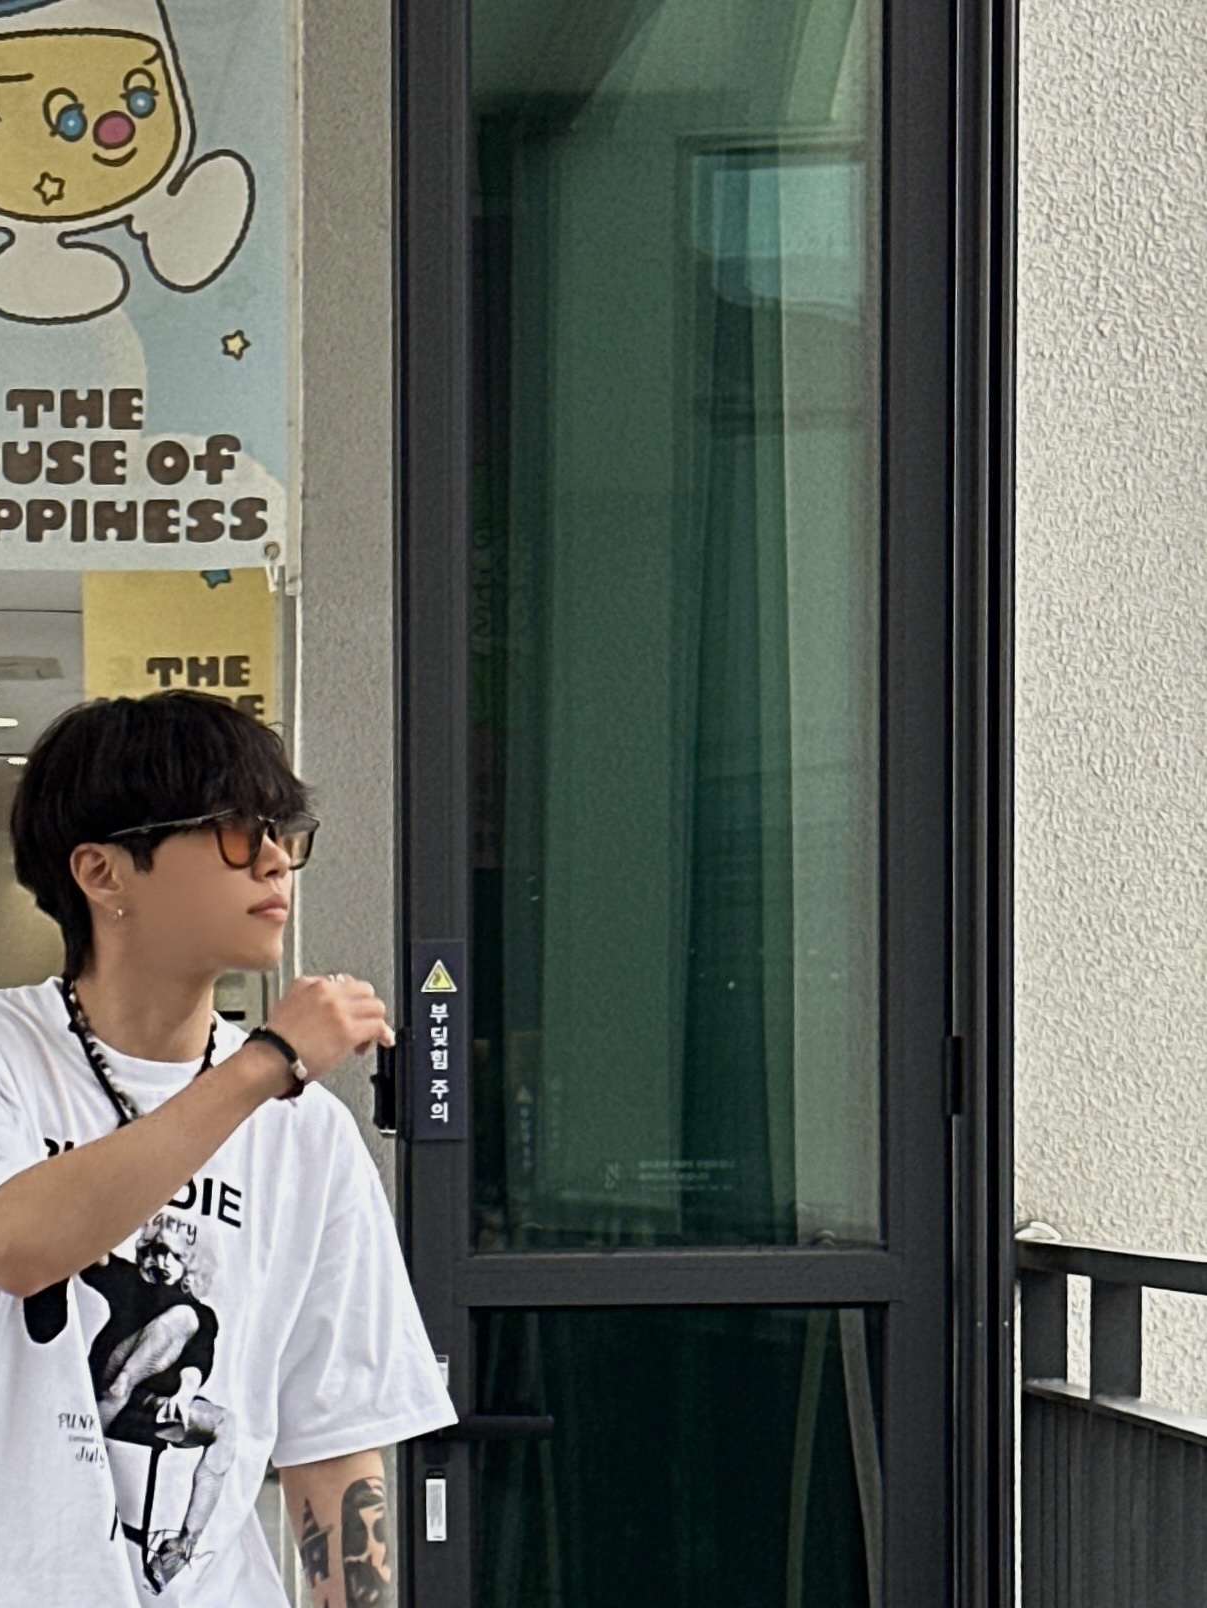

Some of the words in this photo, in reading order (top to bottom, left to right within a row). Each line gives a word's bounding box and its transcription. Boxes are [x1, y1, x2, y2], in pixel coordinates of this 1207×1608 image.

[5, 388, 143, 429] THE
[146, 655, 250, 687] THE
[429, 1003, 449, 1070] 부딪힘
[429, 1079, 450, 1123] 주의
